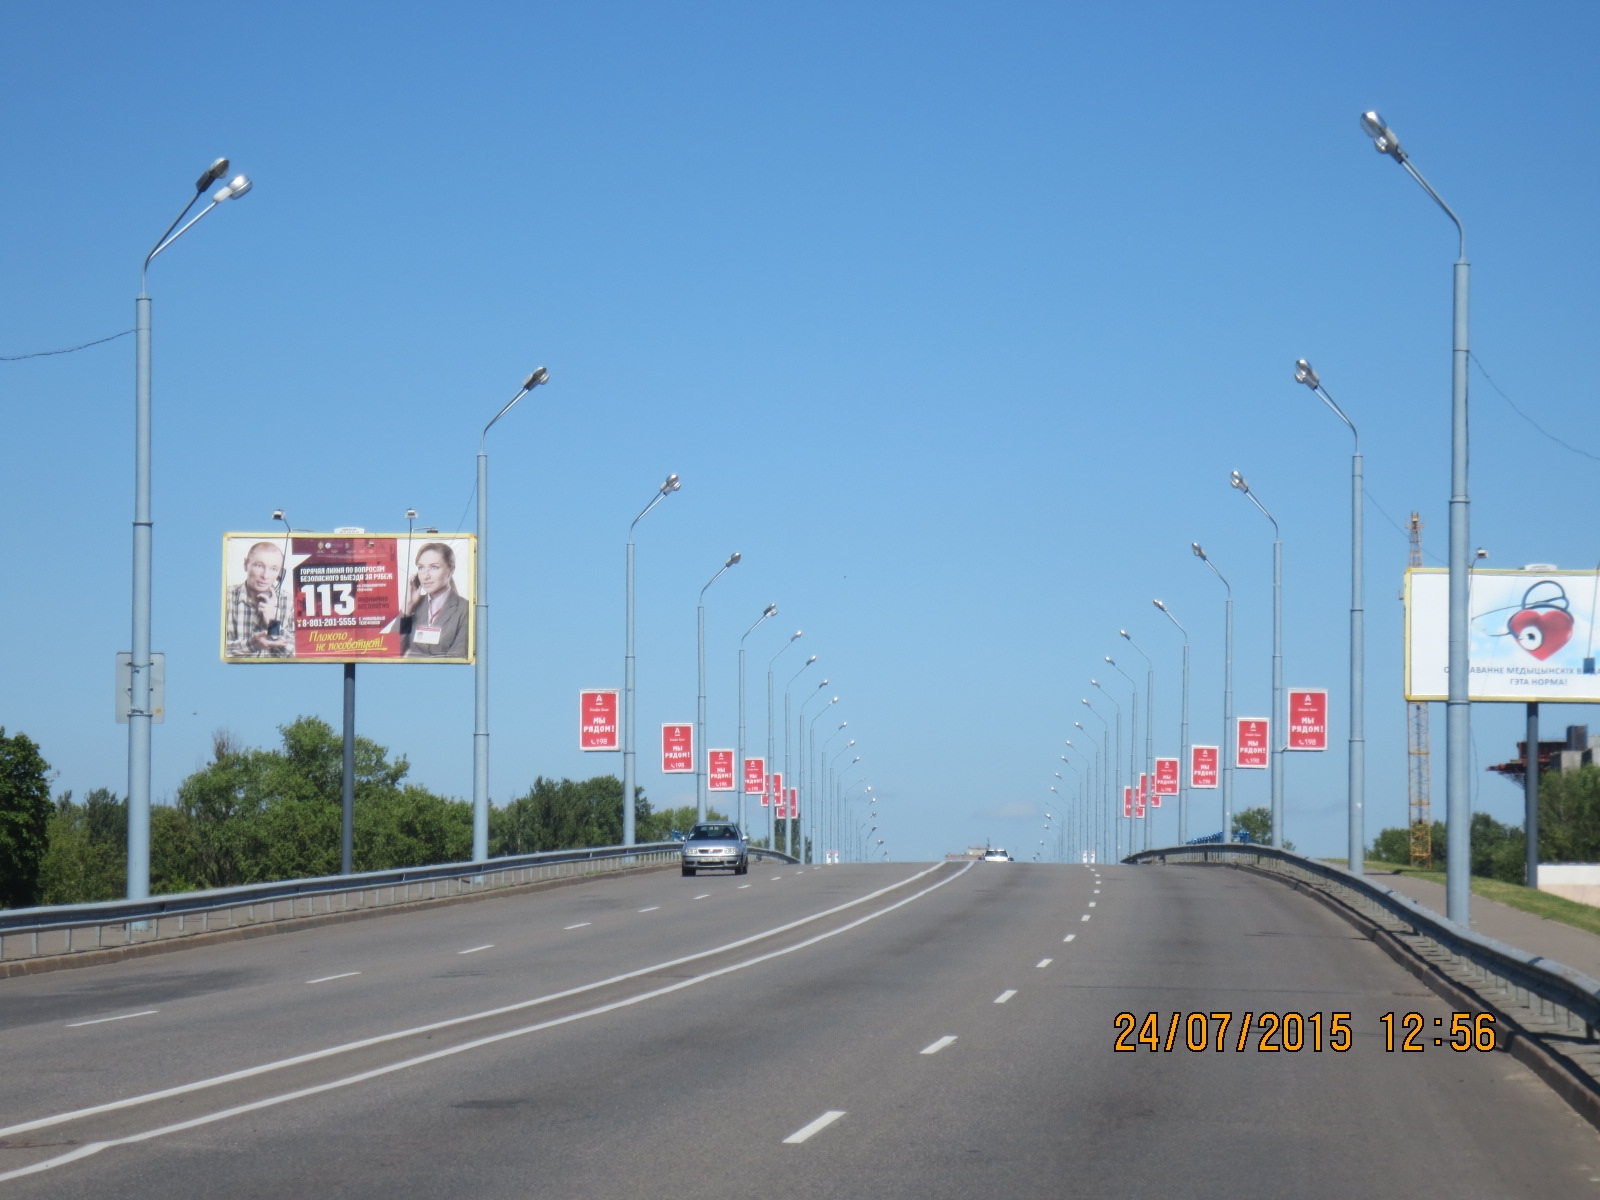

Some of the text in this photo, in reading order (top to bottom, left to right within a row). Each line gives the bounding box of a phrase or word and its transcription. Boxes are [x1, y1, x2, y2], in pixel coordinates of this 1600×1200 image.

[301, 584, 354, 616] 113
[302, 618, 356, 627] 8-801-201-5555
[310, 631, 347, 642] Плохого
[316, 637, 384, 654] не посоветует!
[584, 726, 614, 734] РЯДОМ!
